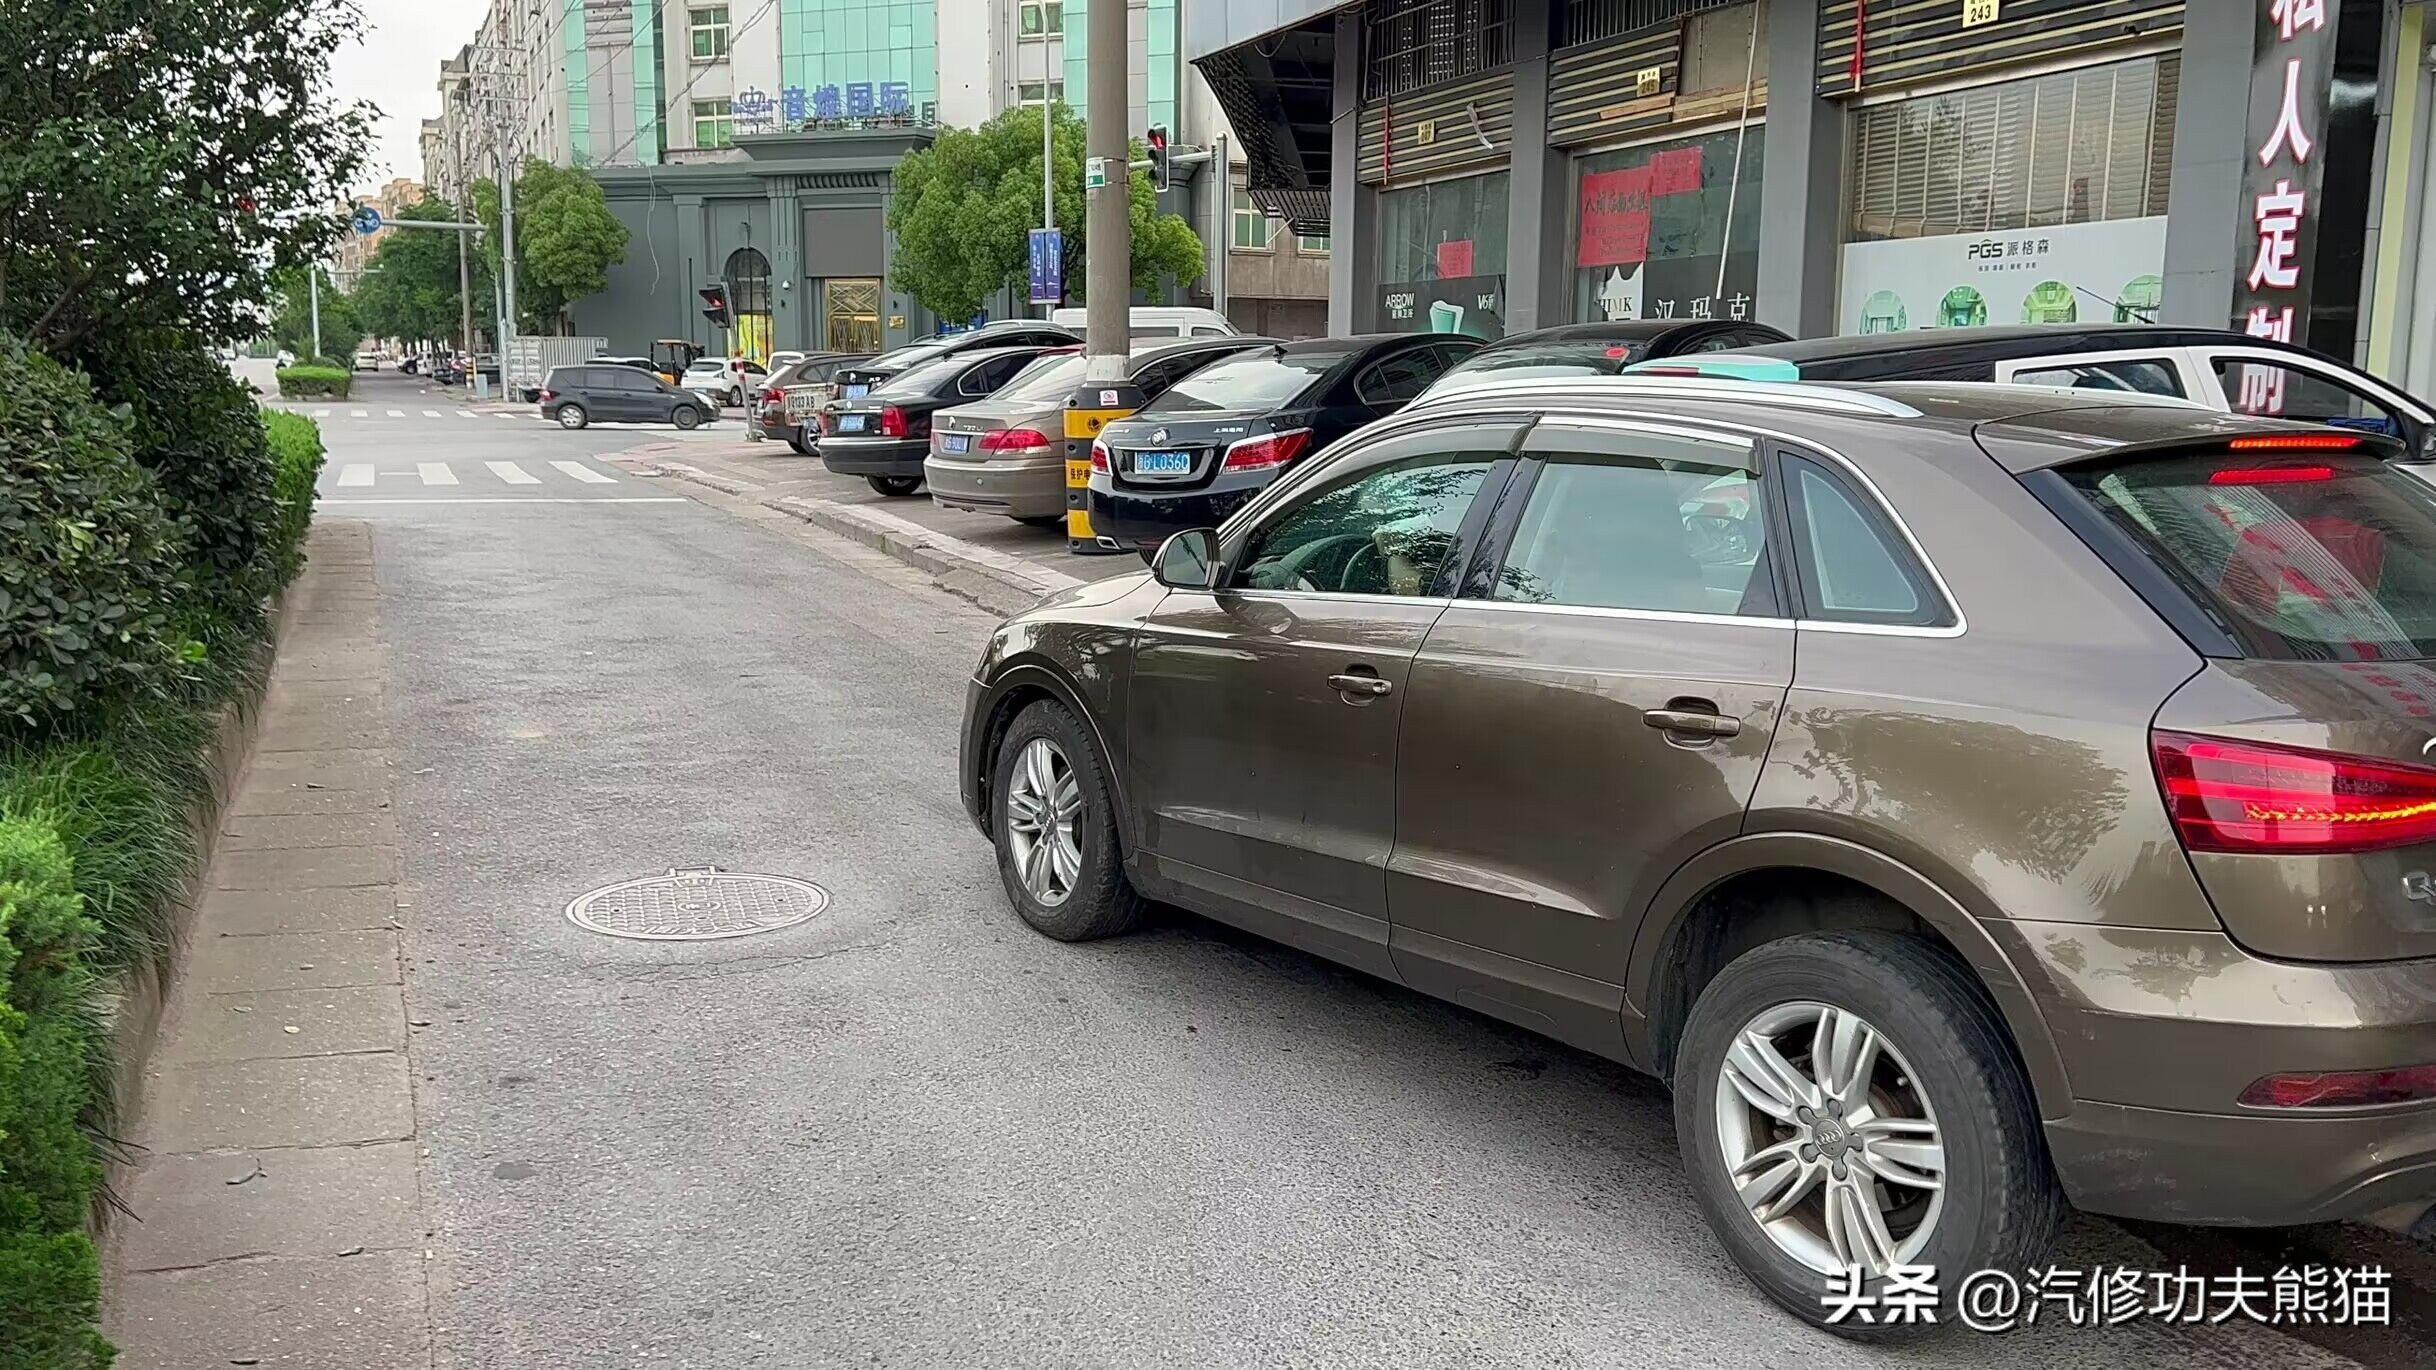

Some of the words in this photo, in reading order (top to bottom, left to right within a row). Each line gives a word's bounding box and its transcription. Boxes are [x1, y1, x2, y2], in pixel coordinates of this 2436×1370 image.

[1970, 4, 1992, 23] 243
[1968, 240, 2004, 260] PGS
[2007, 239, 2049, 256] 派格森
[1385, 293, 1415, 309] ARROW
[1655, 292, 1750, 321] 汉玛克
